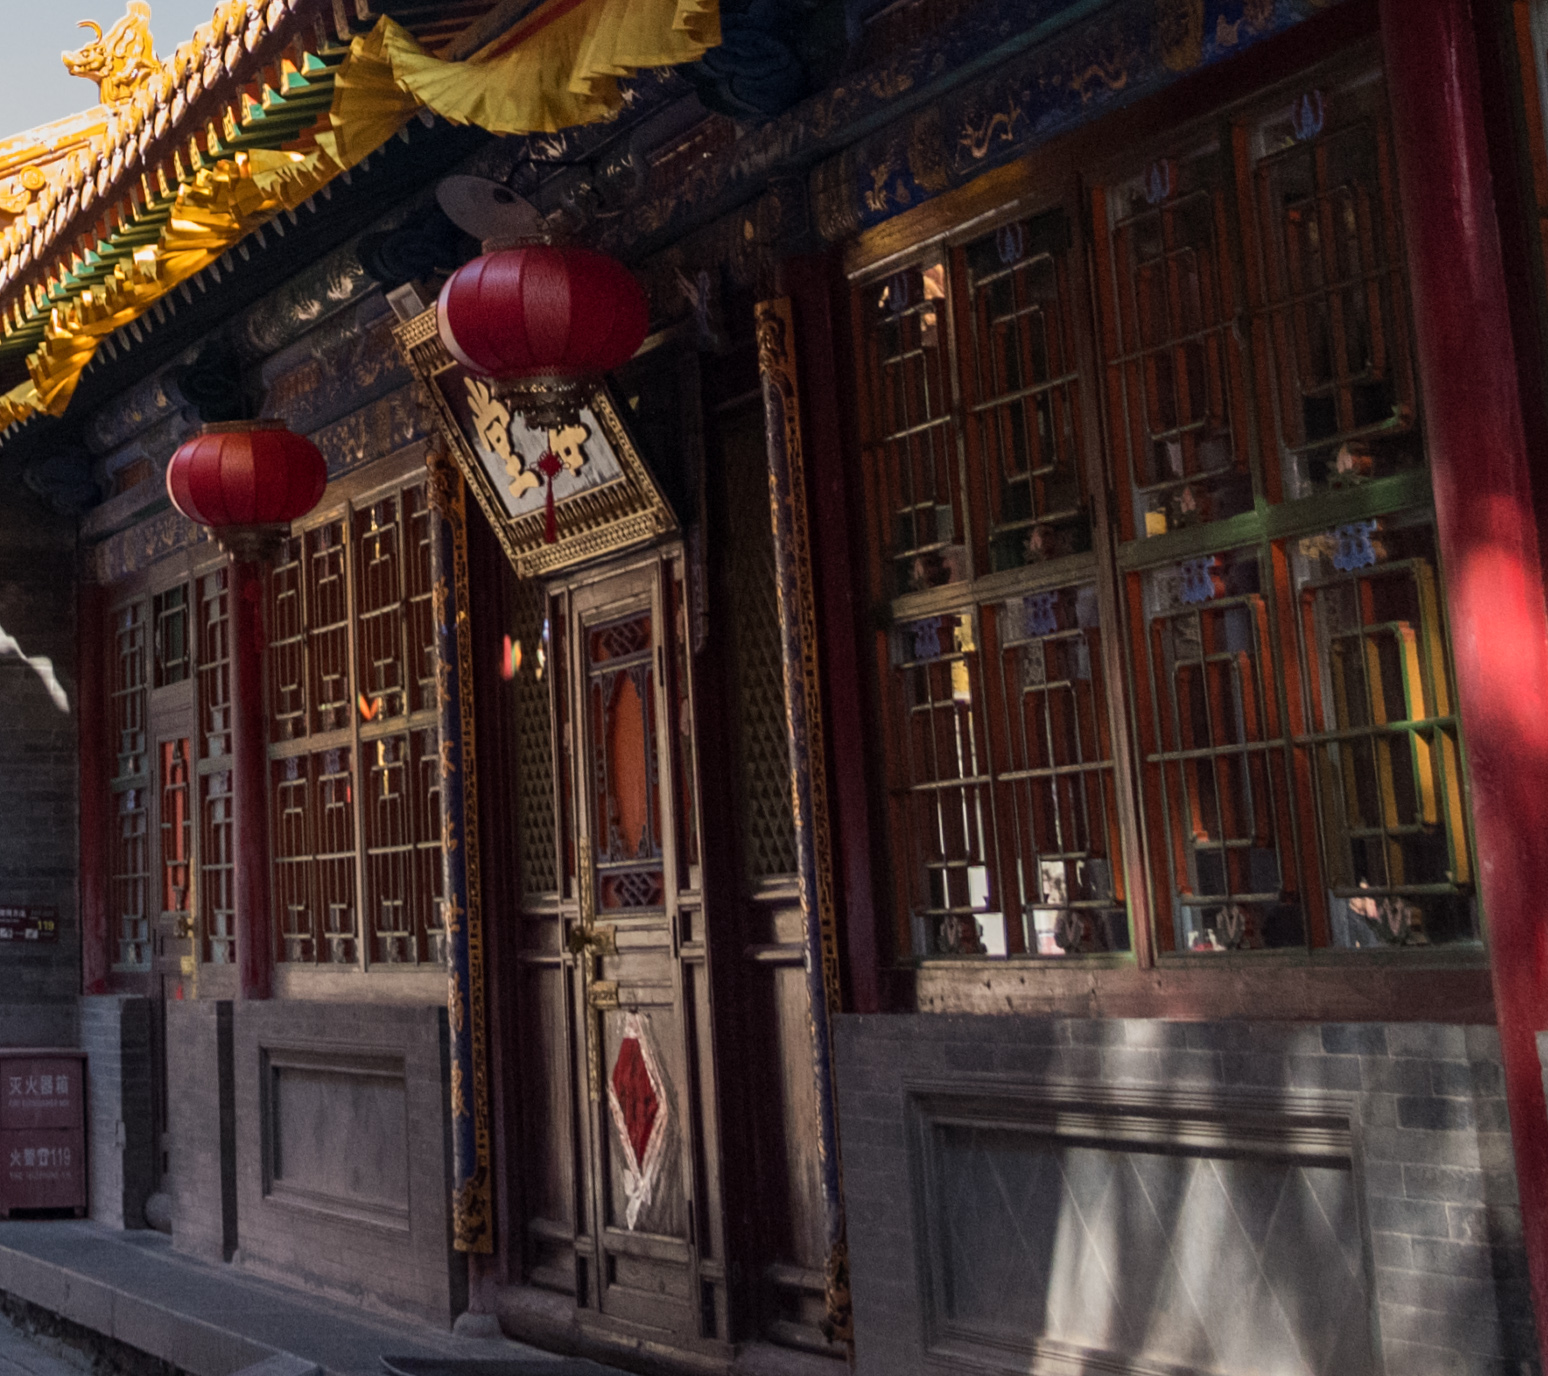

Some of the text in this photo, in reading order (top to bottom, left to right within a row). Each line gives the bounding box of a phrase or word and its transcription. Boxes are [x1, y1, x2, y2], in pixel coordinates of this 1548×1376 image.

[37, 920, 55, 932] 119
[9, 1074, 69, 1096] 灭火器箱
[51, 1146, 71, 1167] 119
